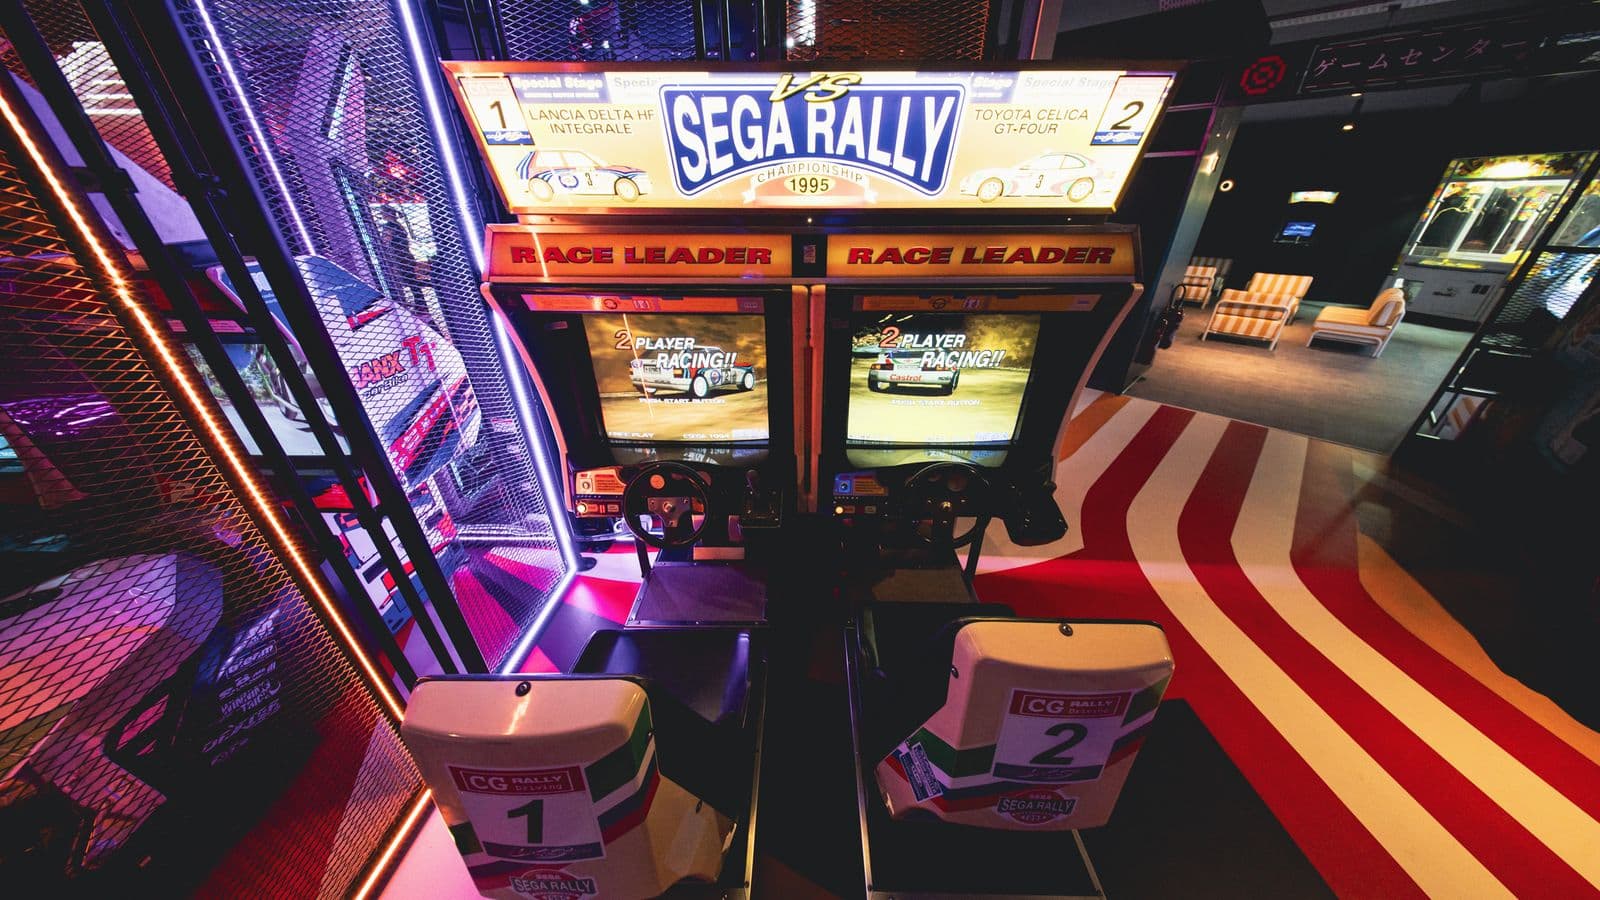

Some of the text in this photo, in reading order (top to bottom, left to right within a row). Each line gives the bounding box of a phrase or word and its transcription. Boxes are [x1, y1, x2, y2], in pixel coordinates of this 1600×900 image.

[1313, 38, 1527, 77] ゲームセンター
[564, 77, 604, 90] Stage
[769, 73, 861, 102] VS
[489, 101, 507, 130] 1
[528, 109, 656, 121] LANCIA DELTA HF
[974, 109, 1089, 121] TOYOTA CELICA
[1110, 100, 1145, 131] 2
[549, 123, 633, 135] INTEGRALE
[673, 94, 956, 183] SEGA RALLY
[994, 123, 1059, 135] GT-FOUR
[757, 162, 863, 184] CHAMPIONSHIP
[789, 176, 830, 194] 1995
[510, 246, 772, 266] RACE LEADER
[847, 246, 1115, 265] RACE LEADER
[614, 329, 696, 351] 2 PLAYER
[878, 325, 967, 349] 2 PLAYER
[656, 351, 738, 370] RACING!!
[919, 350, 1006, 369] RACING!!
[889, 373, 923, 382] Castrol
[1027, 699, 1113, 714] CG RALLY
[1029, 722, 1088, 766] 2
[469, 774, 562, 792] CG RALLY
[1001, 798, 1074, 813] SEGA RALLY
[506, 799, 545, 844] 1
[514, 879, 591, 893] SEGA RALLY
